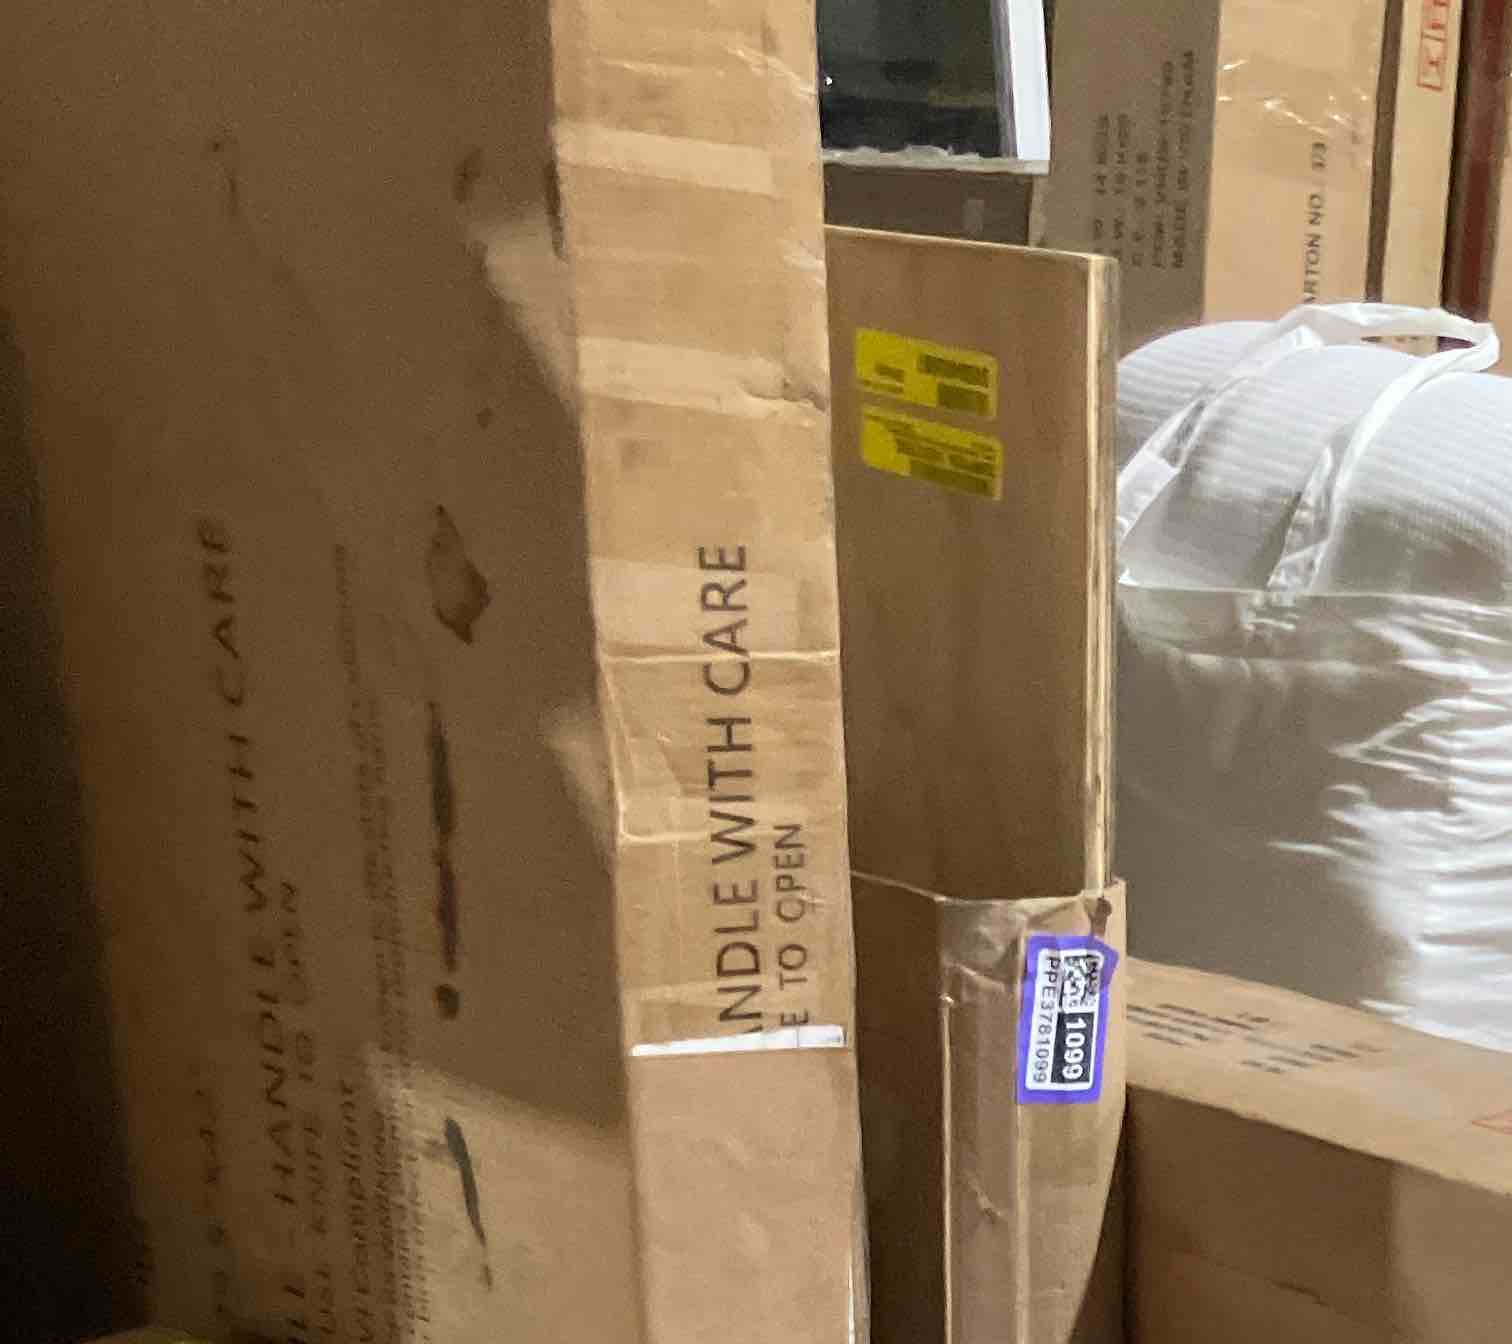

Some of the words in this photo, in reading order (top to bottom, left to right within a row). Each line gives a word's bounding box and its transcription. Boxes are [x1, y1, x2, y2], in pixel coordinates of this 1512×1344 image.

[1302, 234, 1321, 304] ARTON
[697, 543, 752, 697] CARE
[705, 716, 756, 864] WITH
[773, 823, 806, 925] OPEN
[713, 878, 764, 1033] NDLE
[778, 944, 808, 990] TO
[1033, 957, 1063, 1084] PPE3781099
[1061, 1016, 1087, 1081] 1099
